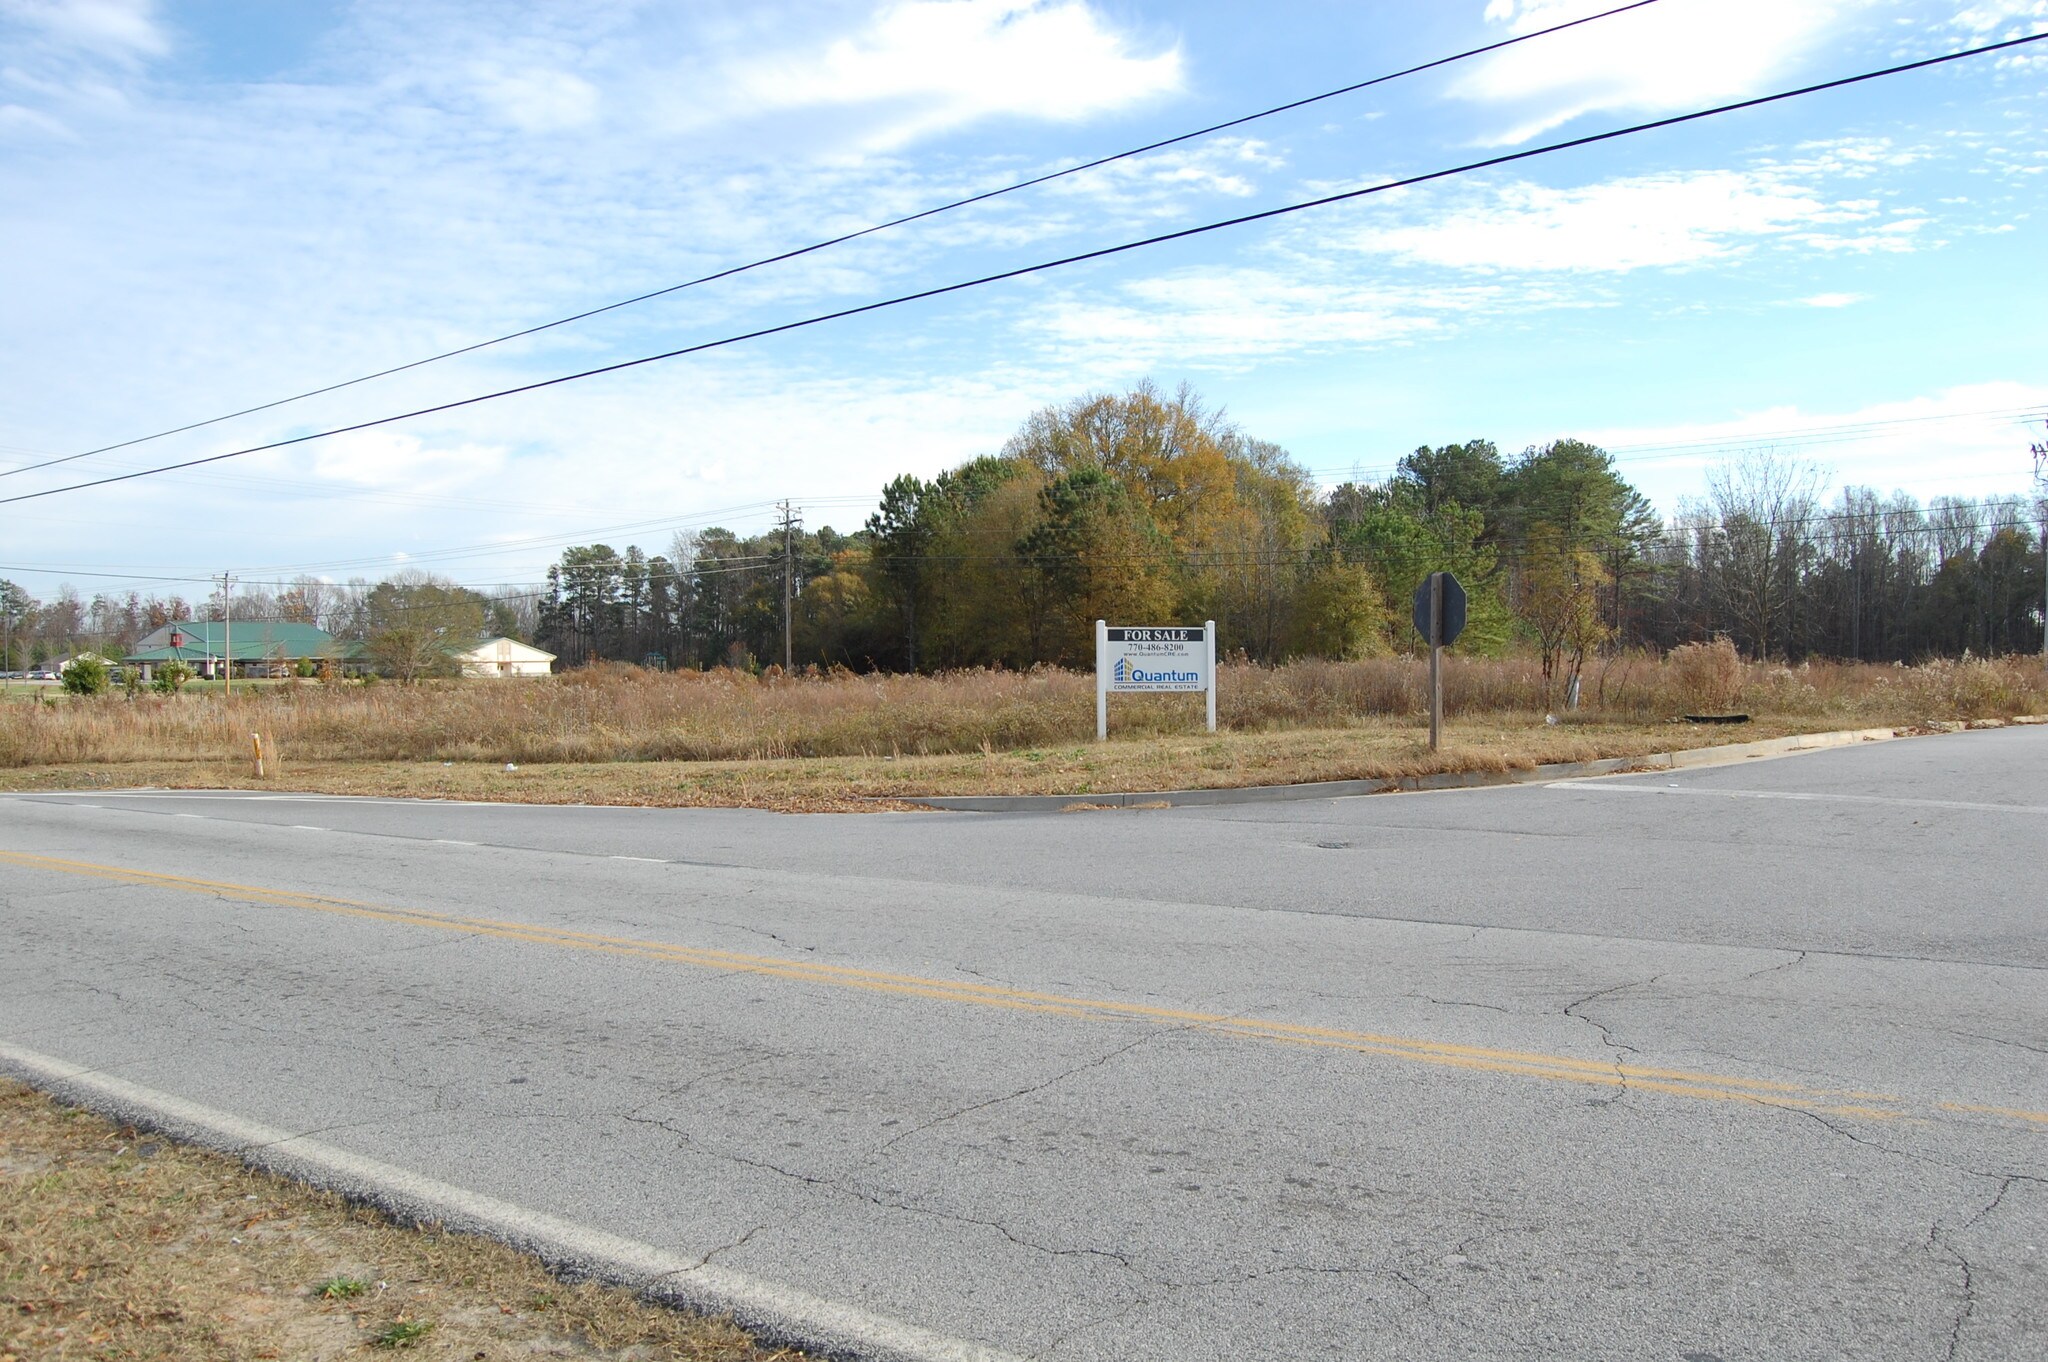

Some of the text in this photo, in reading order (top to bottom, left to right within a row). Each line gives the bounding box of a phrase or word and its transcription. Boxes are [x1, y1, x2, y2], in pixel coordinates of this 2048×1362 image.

[1124, 630, 1188, 640] FOR SALE
[1128, 643, 1184, 651] 770-486-8200
[1132, 669, 1198, 682] Quantum
